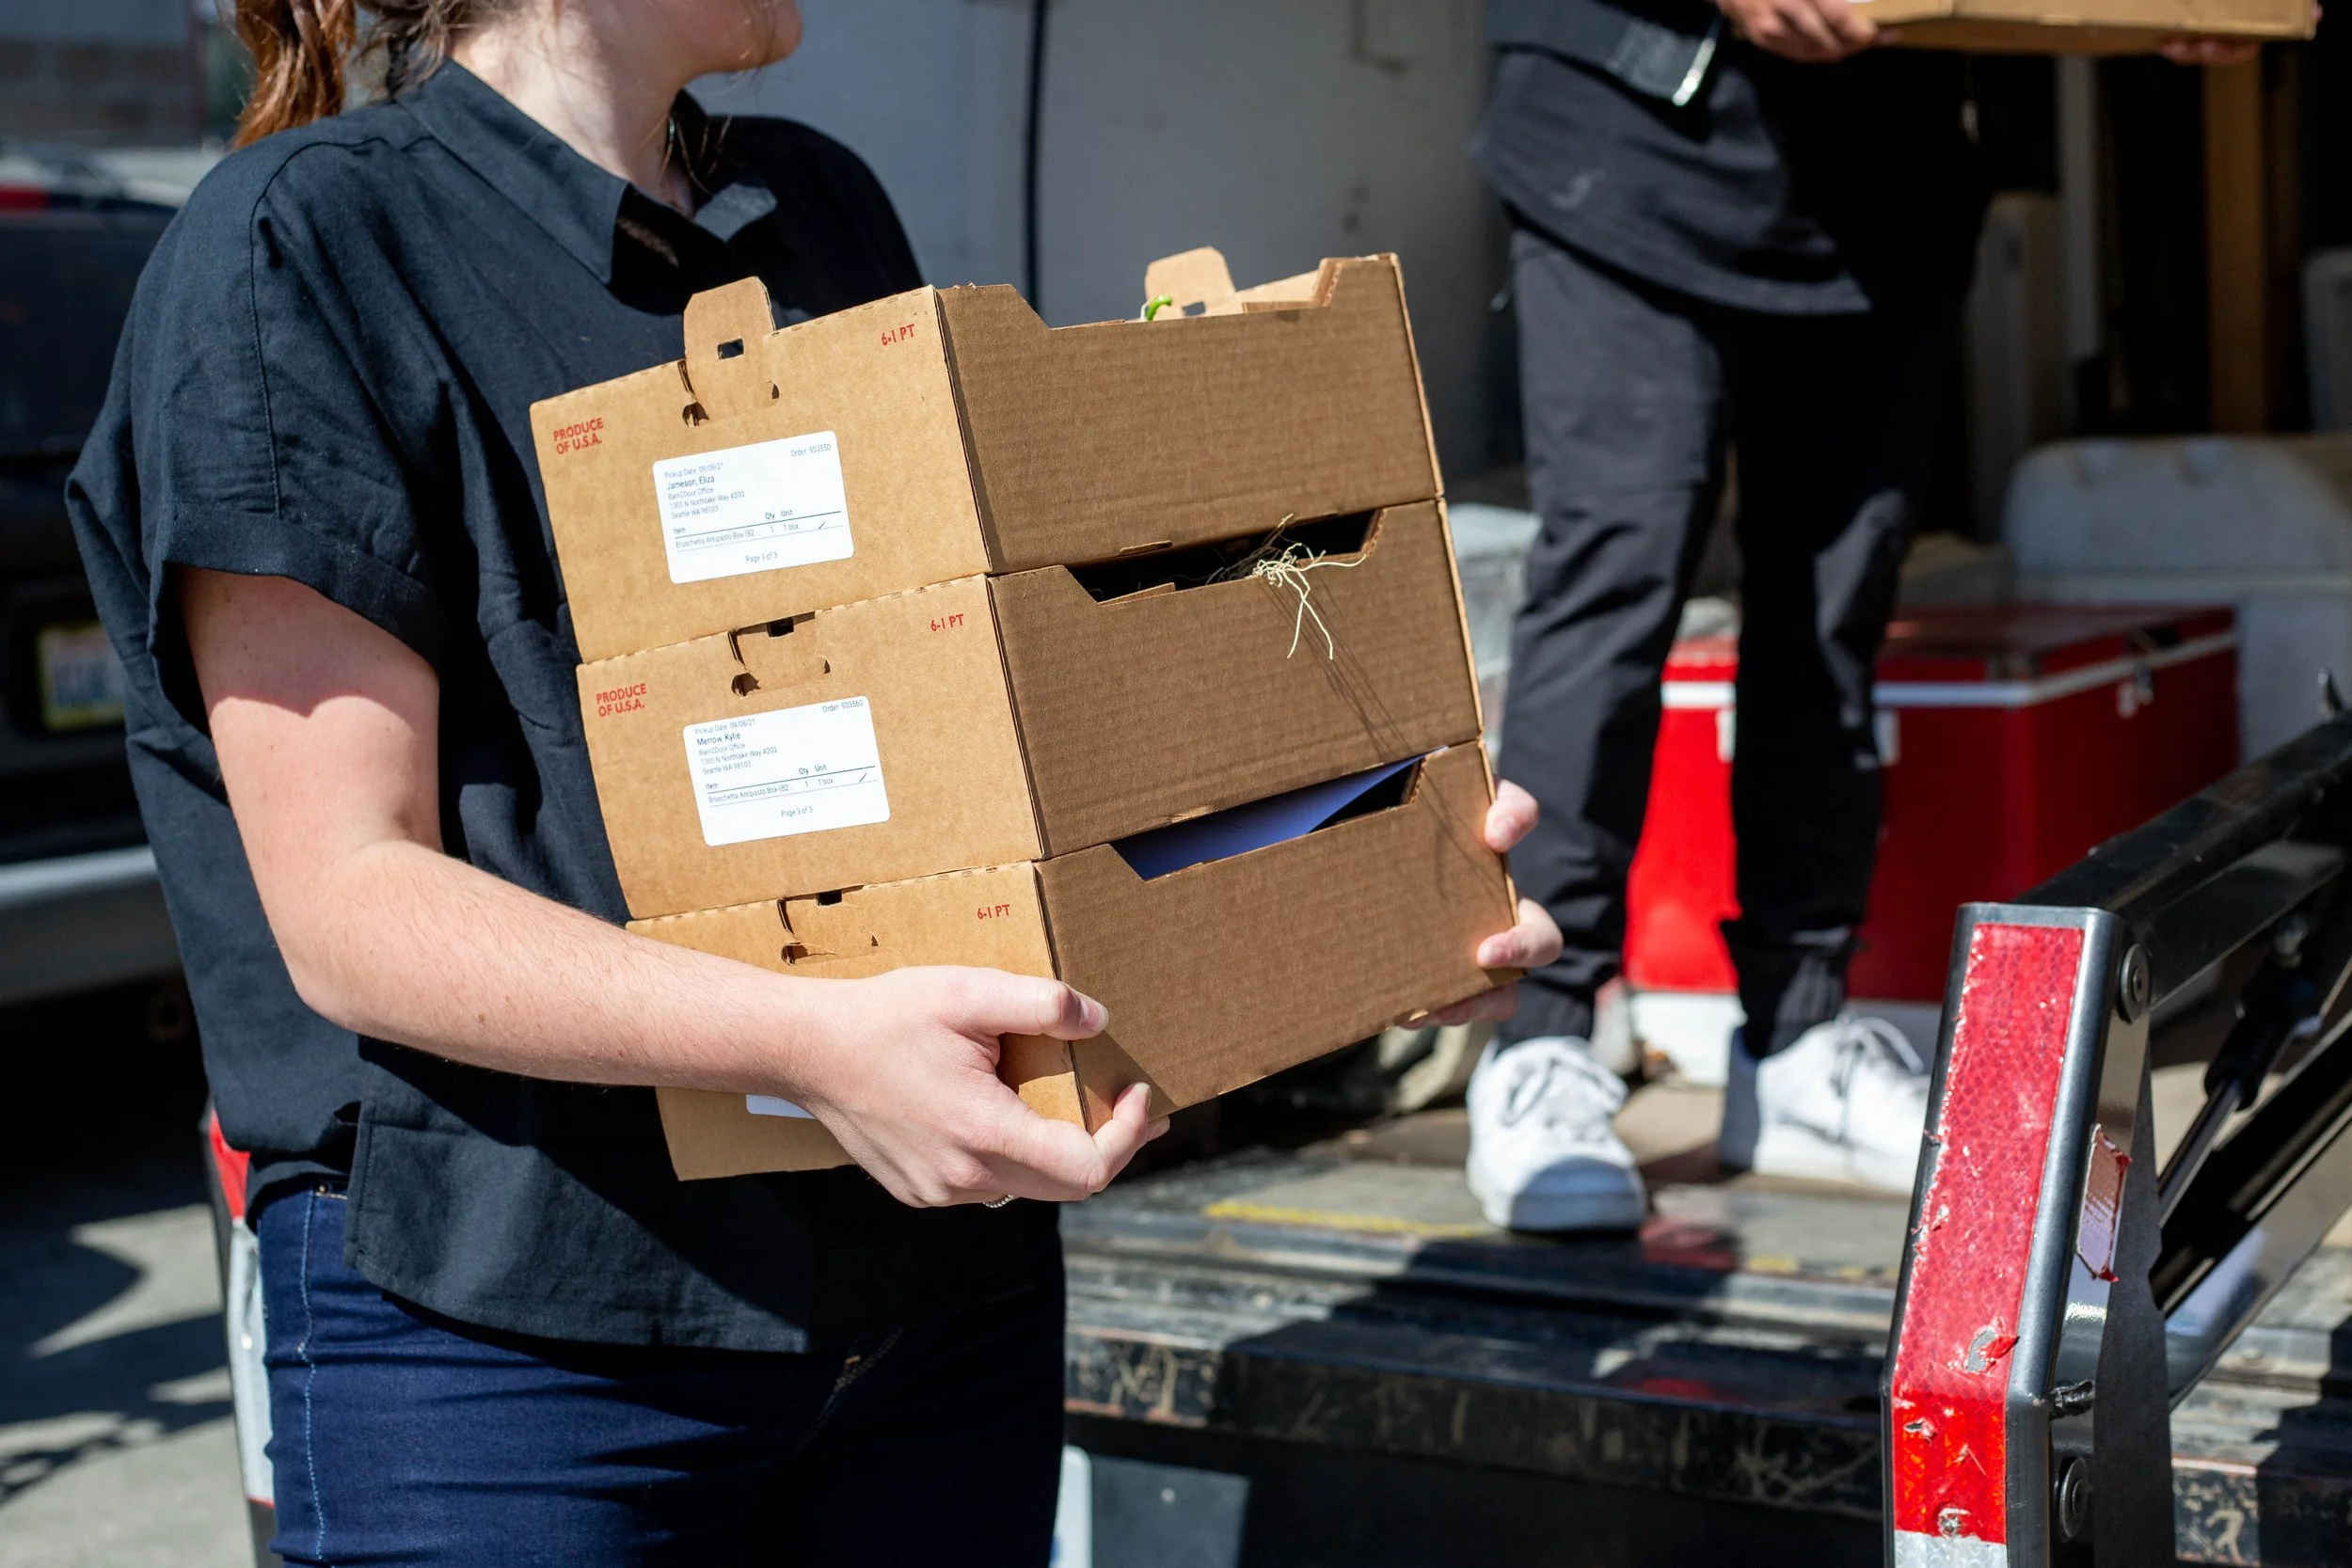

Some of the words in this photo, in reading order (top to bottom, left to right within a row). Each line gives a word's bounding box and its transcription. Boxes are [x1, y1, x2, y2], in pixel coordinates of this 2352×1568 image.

[899, 324, 914, 341] PT
[552, 417, 603, 442] PRODUCE
[556, 441, 570, 454] OF
[572, 433, 602, 450] U.S.A.
[664, 470, 683, 479] Pickup
[666, 479, 698, 490] Jameson,
[699, 476, 715, 485] Eliza
[668, 490, 697, 500] Barn2Door
[698, 487, 714, 496] Office
[690, 498, 716, 507] Northlake
[730, 491, 745, 499] #200
[671, 511, 690, 519] Seattle
[691, 508, 701, 516] WA
[701, 505, 719, 515] 98103
[765, 512, 775, 521] Qty
[781, 509, 793, 517] Unit
[675, 537, 705, 548] Bruschetta
[706, 533, 732, 544] Antipasto
[733, 531, 743, 540] Box
[788, 522, 799, 531] box
[746, 555, 760, 563] Page
[766, 551, 773, 560] of
[930, 617, 946, 631] 6-1
[948, 613, 963, 627] PT
[596, 683, 647, 705] PRODUCE
[598, 705, 612, 717] OF
[614, 699, 645, 714] U.S.A.
[695, 726, 714, 735] Pickup
[697, 736, 723, 746] Merrow,
[724, 732, 740, 742] Kylie
[699, 746, 727, 756] Barn2Door
[729, 742, 745, 751] Office
[722, 752, 748, 762] Northlake
[750, 750, 761, 758] Way
[763, 746, 777, 754] #200
[702, 766, 722, 775] Seattle
[734, 760, 752, 769] 98103
[799, 767, 809, 775] Qty
[815, 764, 827, 772] Unit
[708, 793, 739, 803] Bruschetta
[739, 788, 766, 798] Antipasto
[781, 810, 796, 818] Page
[802, 806, 808, 815] of
[809, 805, 814, 814] 3
[977, 906, 993, 920] 6-1
[994, 904, 1009, 917] PT
